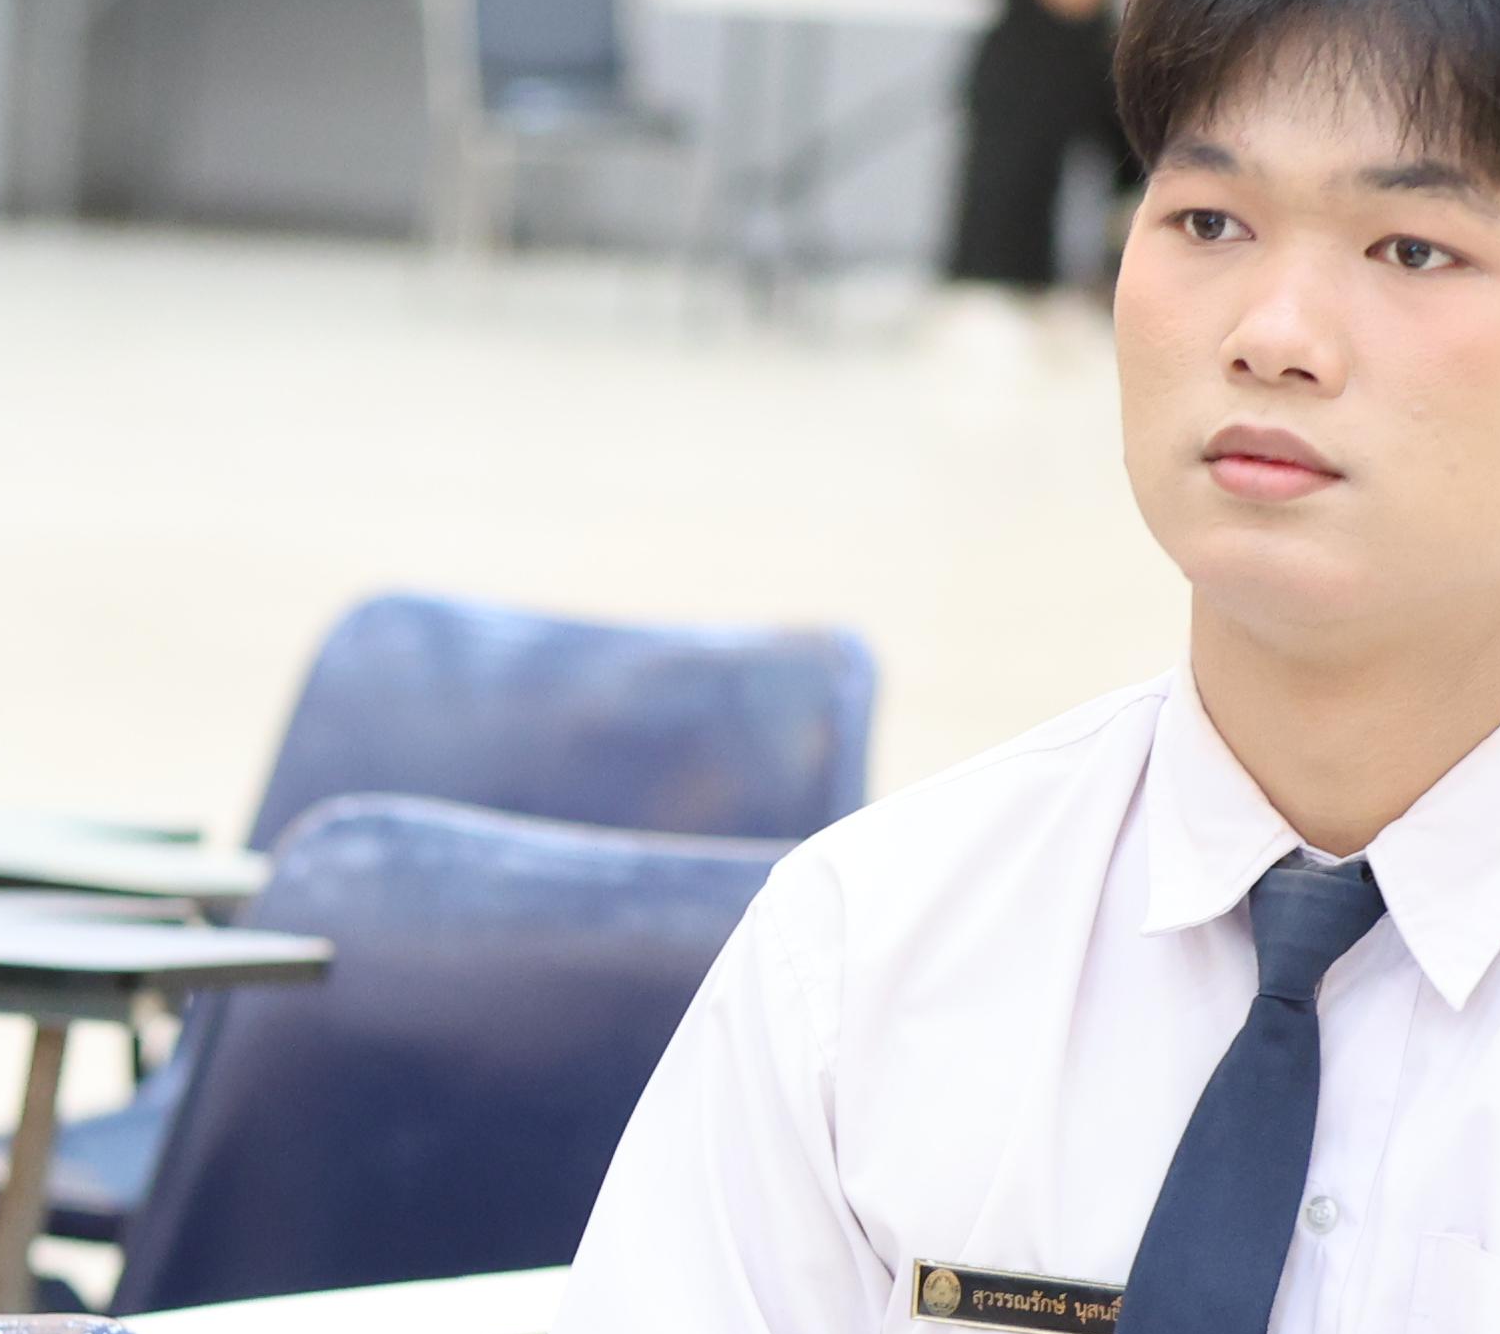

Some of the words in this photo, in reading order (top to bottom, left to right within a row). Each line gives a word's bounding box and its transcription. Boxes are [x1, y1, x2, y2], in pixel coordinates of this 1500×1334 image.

[972, 1289, 1068, 1315] สุวรรณรักษ์
